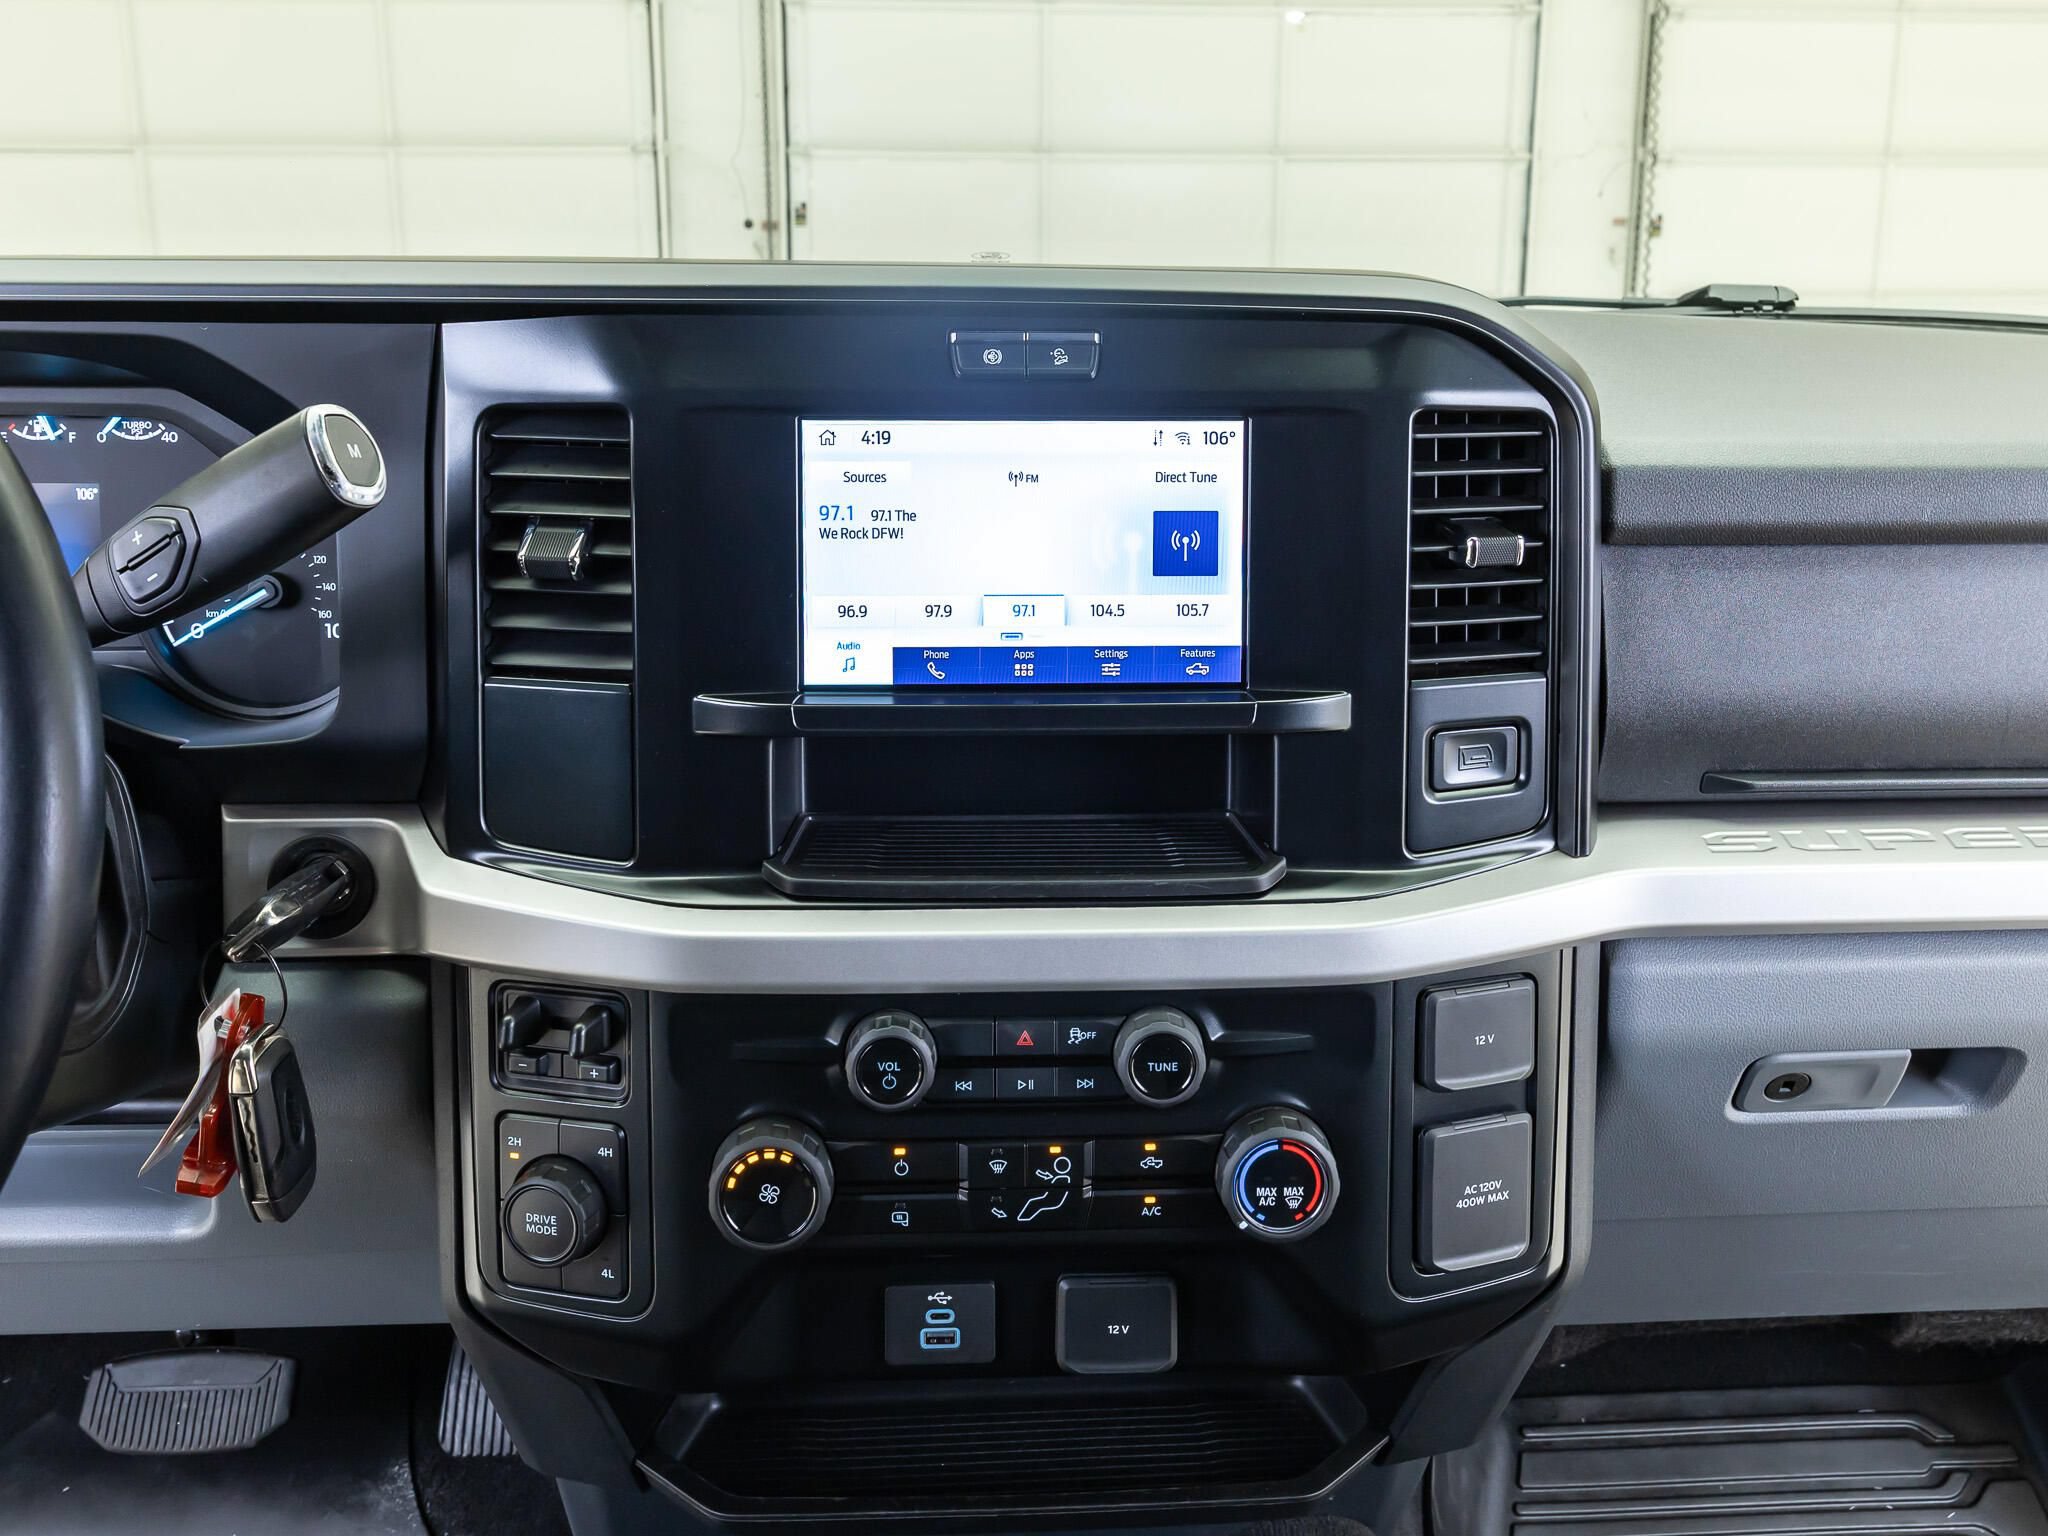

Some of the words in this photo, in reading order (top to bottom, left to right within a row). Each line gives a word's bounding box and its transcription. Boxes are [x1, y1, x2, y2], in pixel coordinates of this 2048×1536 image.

[122, 421, 152, 430] TURBO
[69, 432, 76, 443] F
[160, 431, 179, 443] 40
[862, 431, 890, 444] 4:19
[1204, 431, 1235, 445] 106°
[347, 444, 362, 458] M
[844, 472, 886, 482] Sources
[1026, 474, 1038, 482] FM
[1156, 472, 1186, 482] Direct
[1190, 472, 1217, 482] Tune
[76, 488, 98, 500] 106°
[820, 505, 852, 520] 97.1
[871, 510, 891, 521] 97.1
[895, 510, 916, 521] The
[819, 528, 837, 539] We
[841, 527, 868, 539] Rock
[872, 528, 903, 539] DFW!
[313, 555, 327, 565] 120
[322, 583, 336, 591] 140
[318, 610, 332, 618] 160
[838, 605, 867, 617] 96.9
[925, 605, 952, 617] 97.9
[1013, 605, 1035, 616] 97.1
[1091, 604, 1124, 616] 104.5
[1177, 604, 1208, 616] 105.7
[837, 642, 860, 650] Audio
[924, 650, 949, 658] Phone
[1014, 650, 1034, 659] Apps
[1095, 649, 1128, 659] Settings
[1181, 649, 1215, 657] Features
[1081, 1032, 1096, 1040] OFF
[1475, 1036, 1485, 1045] 12
[1488, 1034, 1494, 1043] V
[878, 1062, 900, 1071] VOL
[1148, 1062, 1178, 1071] TUNE
[508, 1137, 521, 1146] 2H
[598, 1147, 612, 1157] 4H
[1257, 1188, 1277, 1196] MAX
[1284, 1187, 1304, 1197] MAX
[1464, 1185, 1477, 1195] AC
[1479, 1180, 1503, 1193] 120V
[1259, 1197, 1275, 1206] A/C
[1456, 1196, 1485, 1208] 400W
[1487, 1191, 1510, 1204] MAX
[1142, 1207, 1161, 1216] A/C
[526, 1213, 557, 1225] DRIVE
[526, 1224, 558, 1235] MODE
[602, 1269, 614, 1278] 4L
[1108, 1325, 1119, 1334] 12
[1122, 1325, 1129, 1334] V
